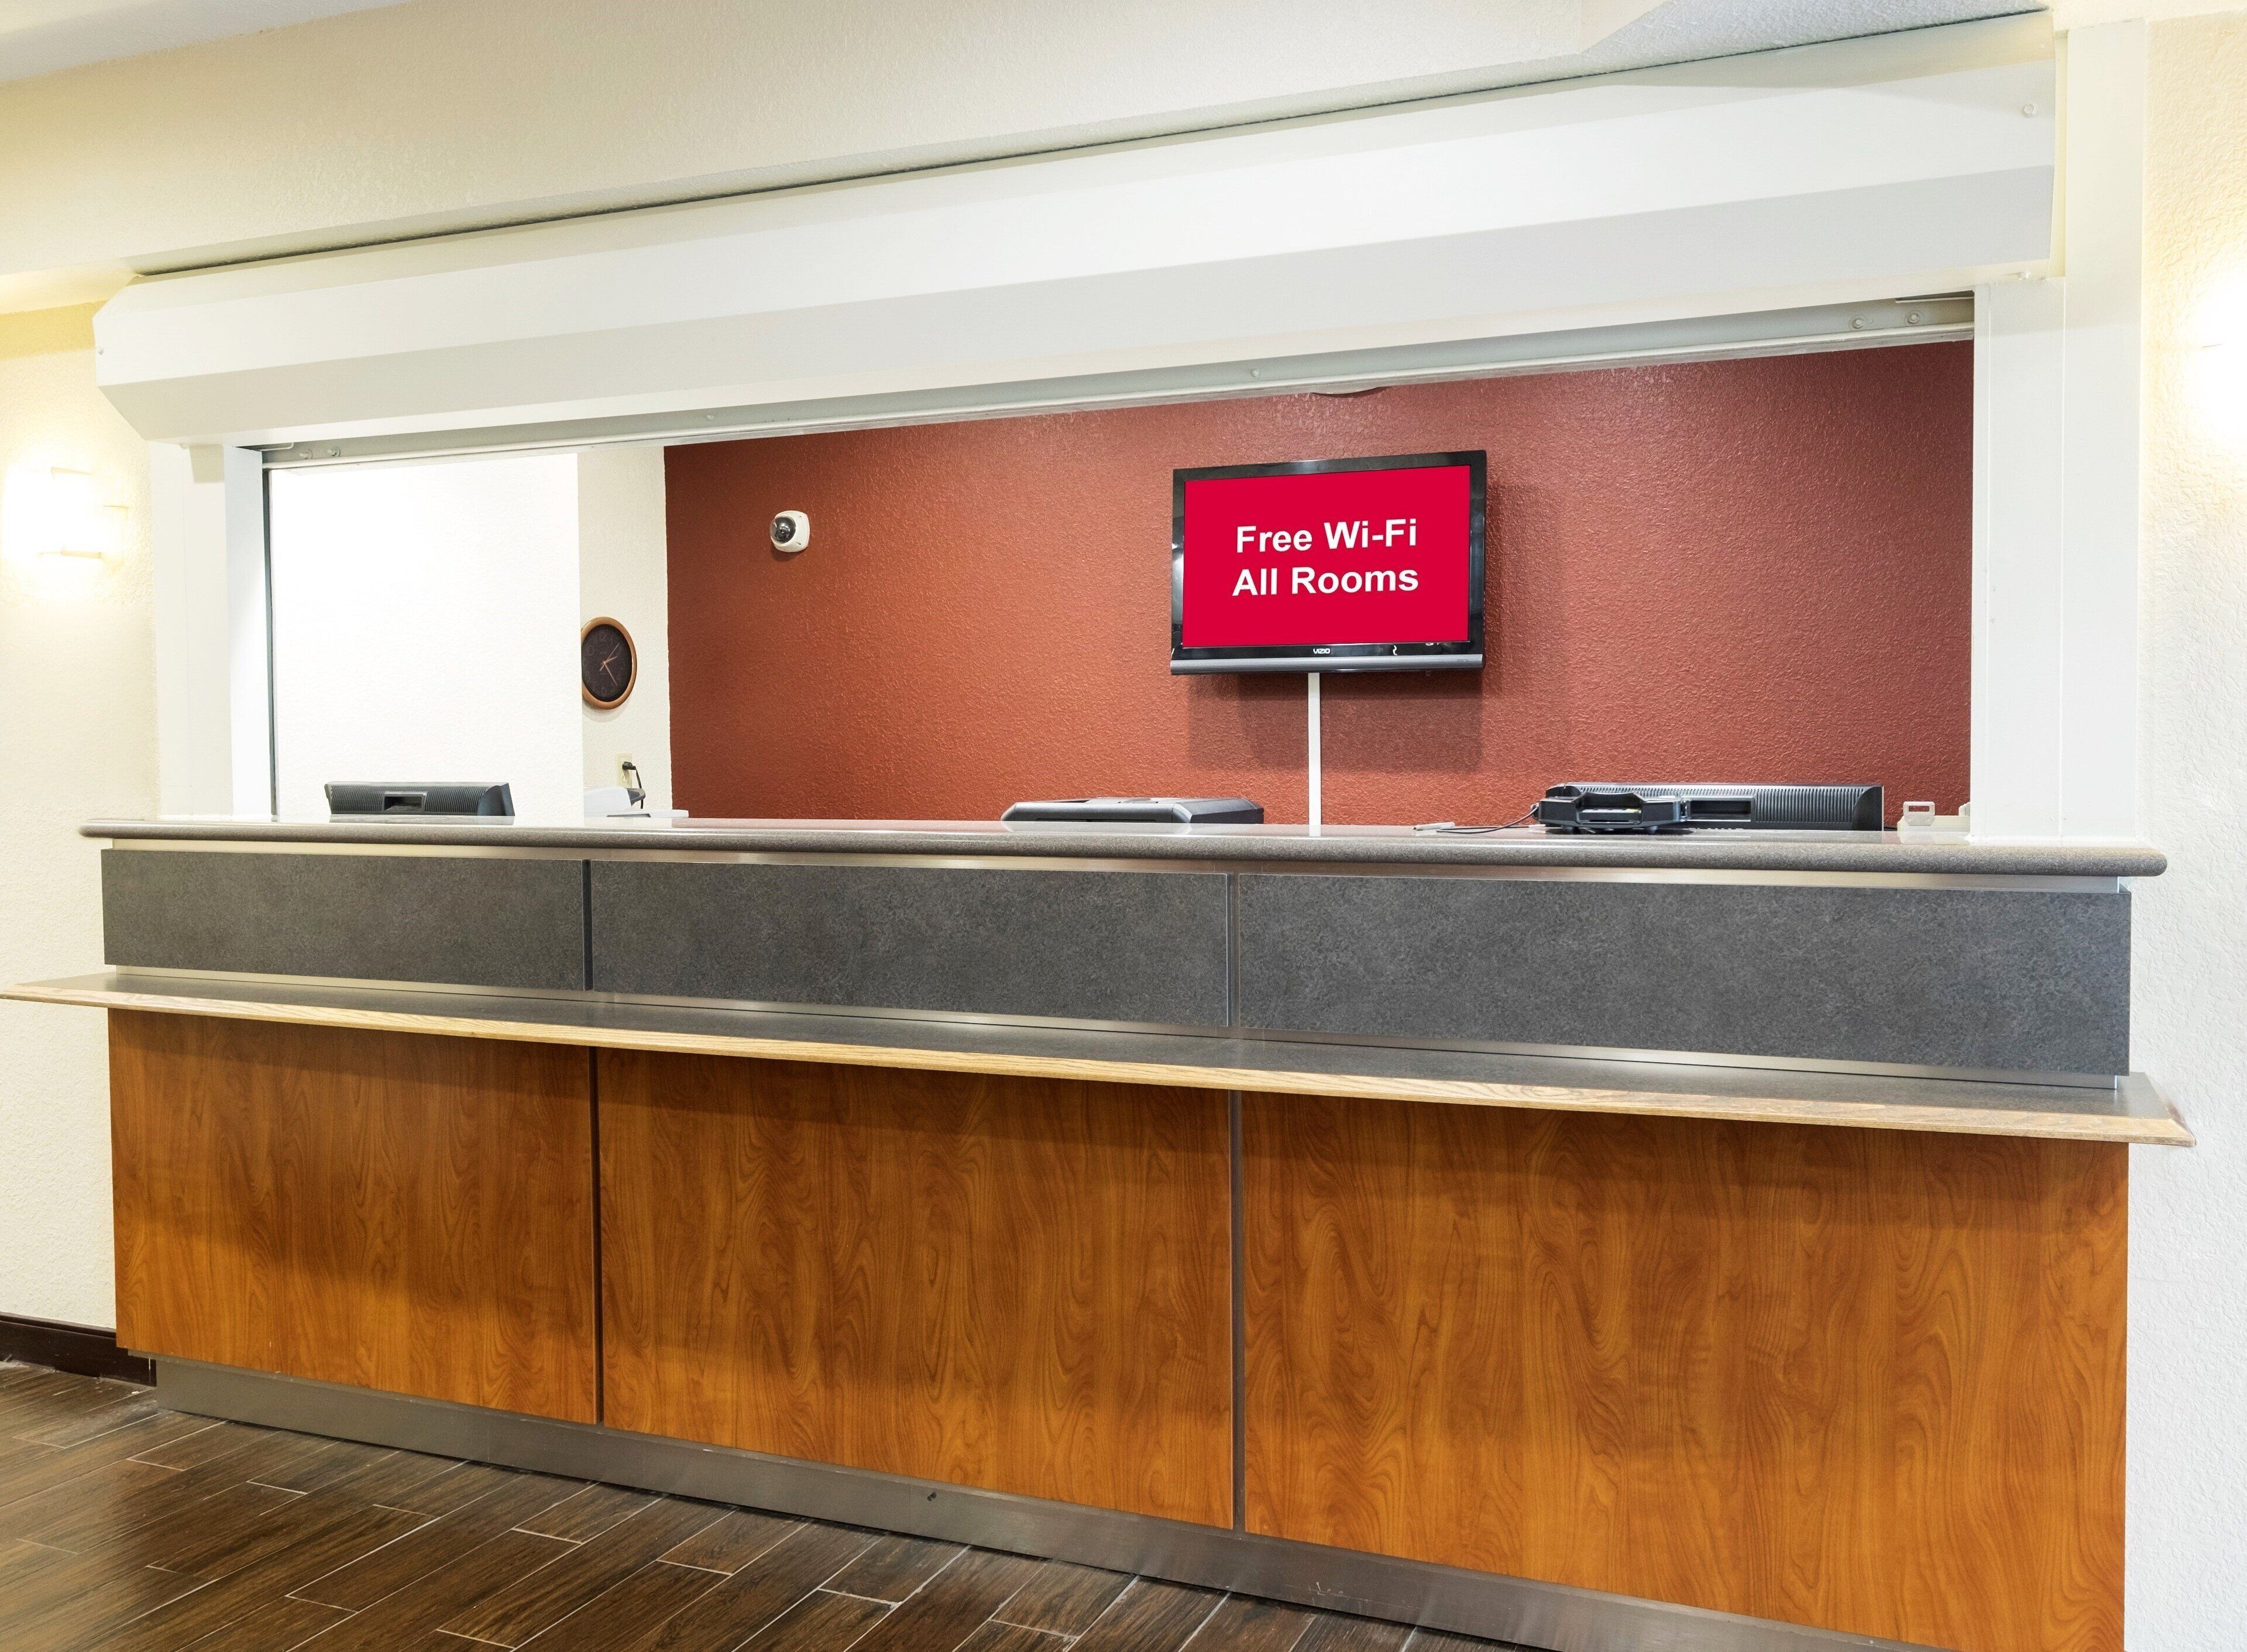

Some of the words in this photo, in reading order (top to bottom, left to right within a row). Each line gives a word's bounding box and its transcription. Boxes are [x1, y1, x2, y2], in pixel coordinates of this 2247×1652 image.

[1236, 526, 1313, 553] Free
[1324, 518, 1417, 549] Wi-Fi
[1232, 568, 1277, 596] All
[1291, 566, 1419, 595] Rooms
